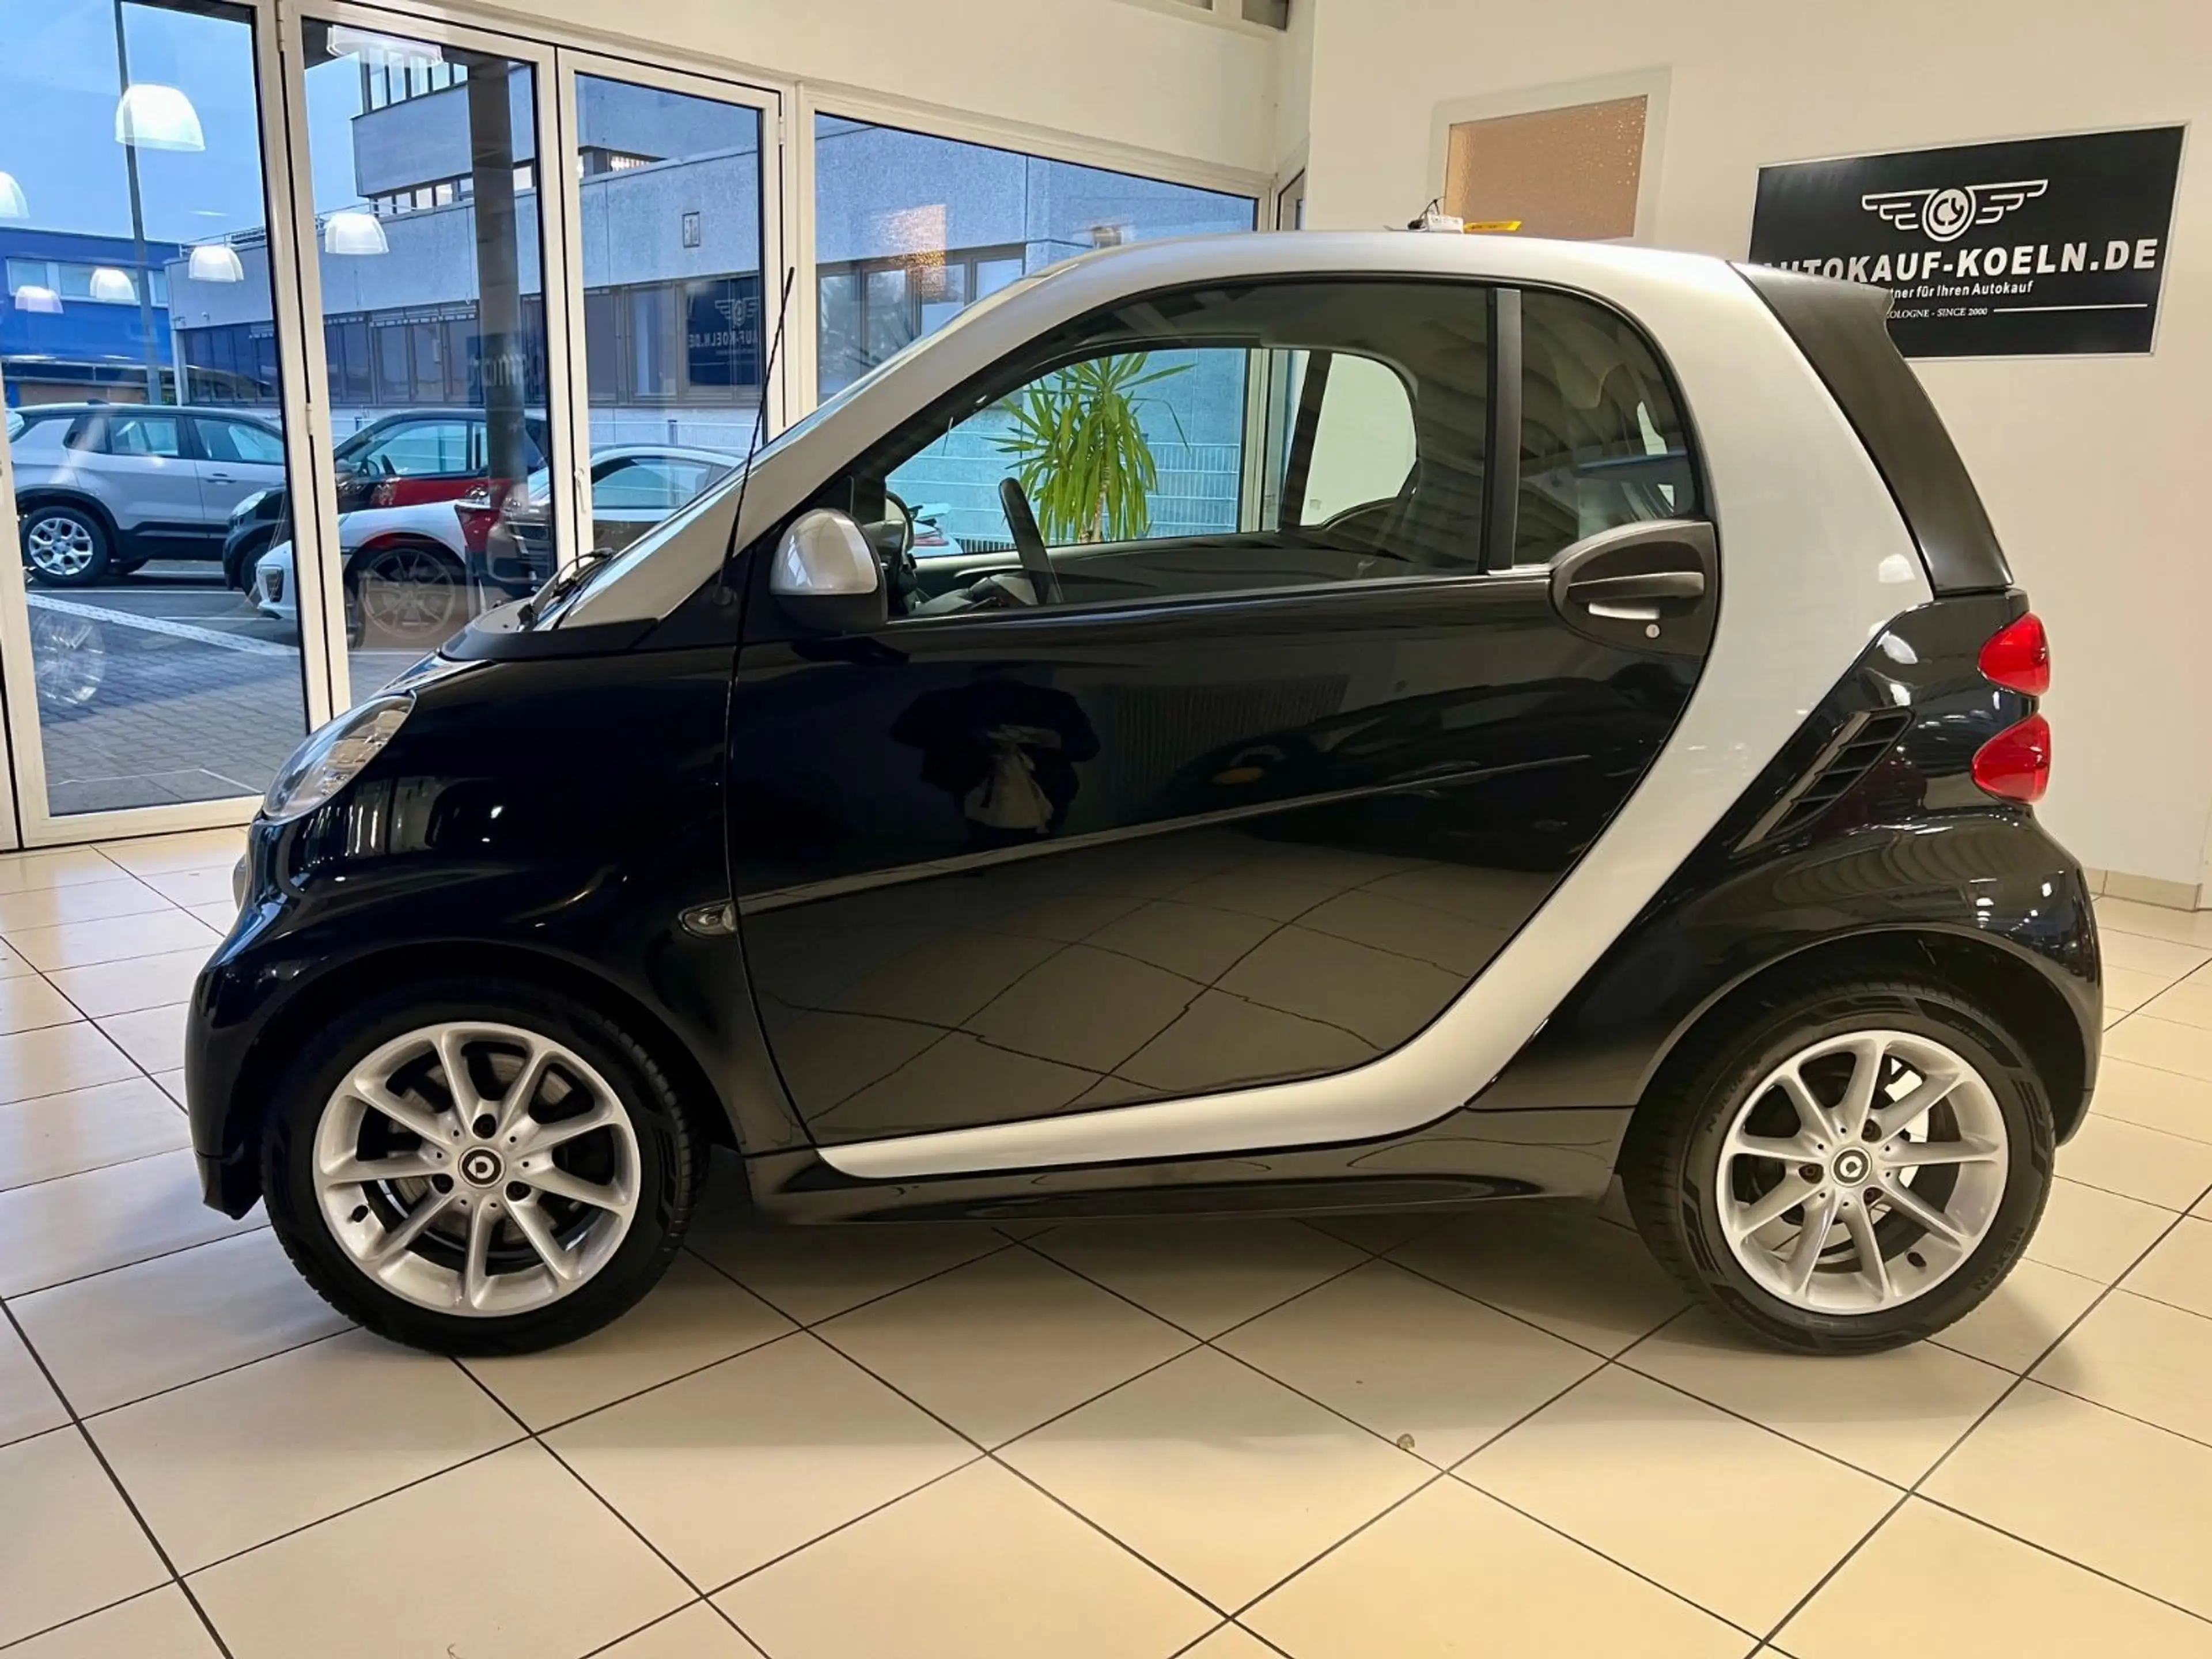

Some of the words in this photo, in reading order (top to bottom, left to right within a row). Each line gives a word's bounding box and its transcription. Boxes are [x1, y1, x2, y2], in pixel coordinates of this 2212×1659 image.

[1763, 238, 2158, 283] TOKAUF-KOELN.DE
[1916, 285, 1935, 298] für
[1936, 284, 1970, 297] Ihren
[1971, 280, 2034, 296] Autokauf
[1887, 309, 1930, 319] OLOGNE
[1937, 308, 1966, 317] SINCE
[1967, 307, 1988, 316] 2000
